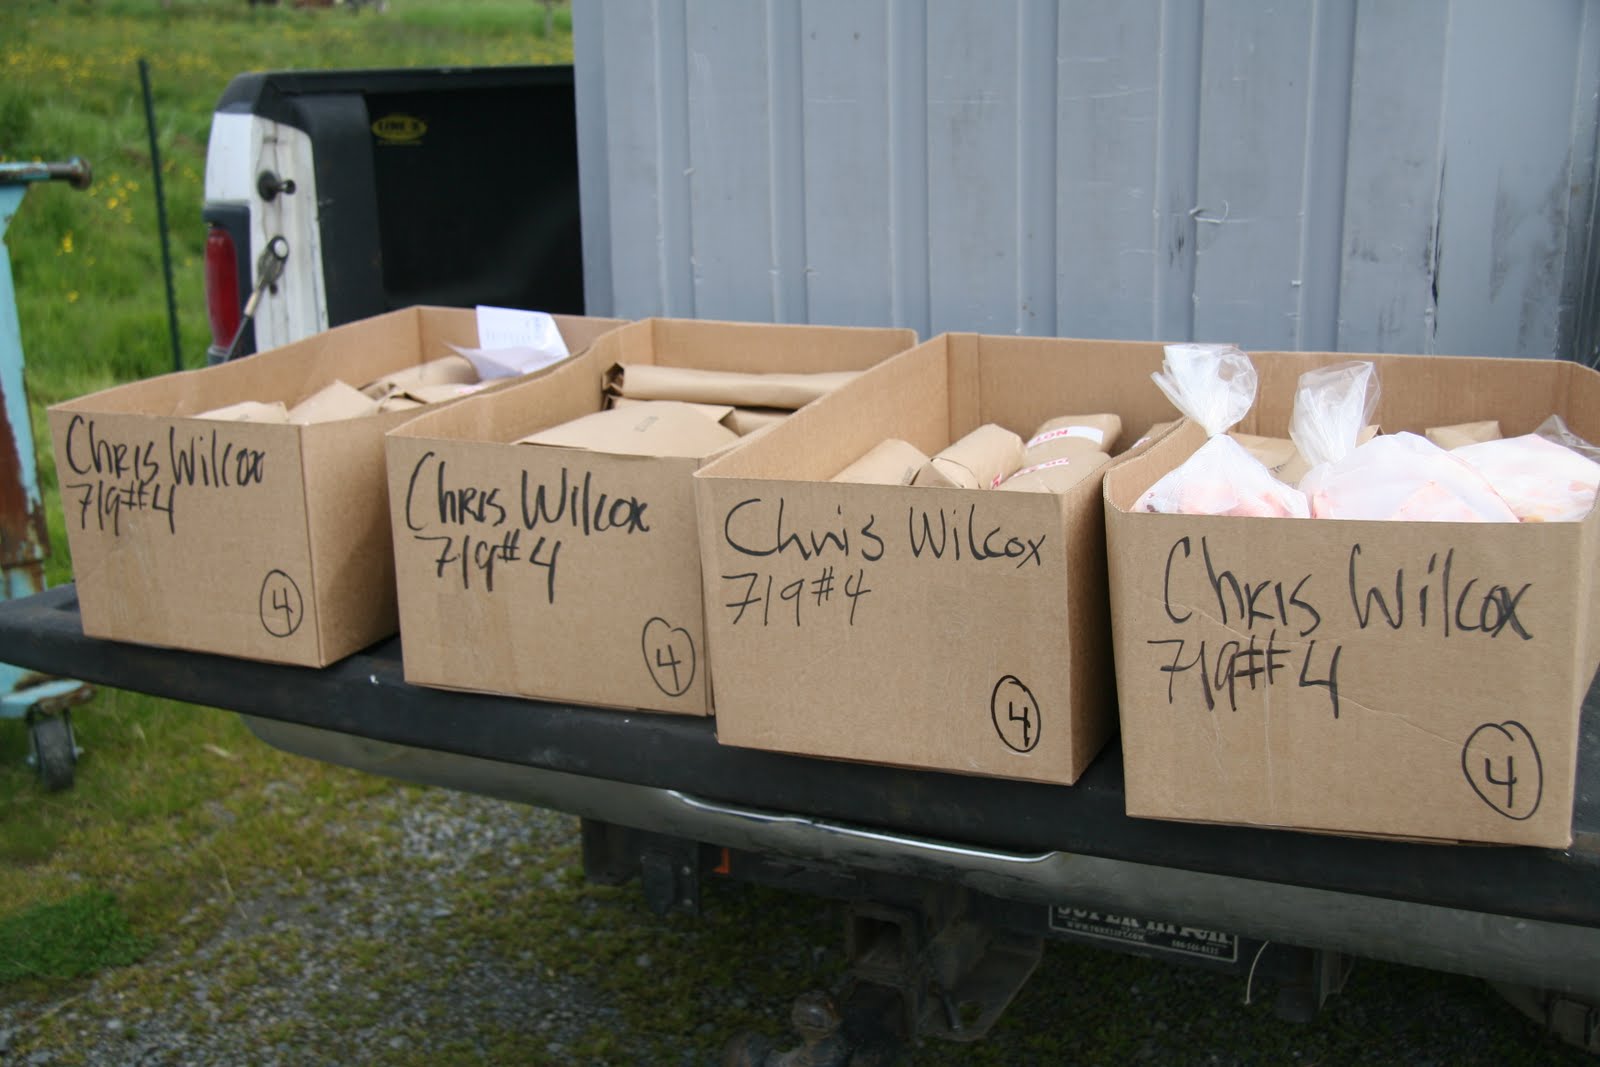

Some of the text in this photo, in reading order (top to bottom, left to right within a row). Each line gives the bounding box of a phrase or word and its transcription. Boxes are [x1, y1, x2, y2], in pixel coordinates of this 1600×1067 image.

[66, 415, 265, 488] Chris Wilcox
[406, 452, 650, 536] Chris Wilcox
[724, 498, 1046, 568] Chris Wilcox
[273, 588, 294, 634] 4
[1164, 536, 1534, 641] Chris Wilcox
[656, 644, 682, 692] 4
[1008, 701, 1031, 748] 4
[1485, 755, 1517, 809] 4
